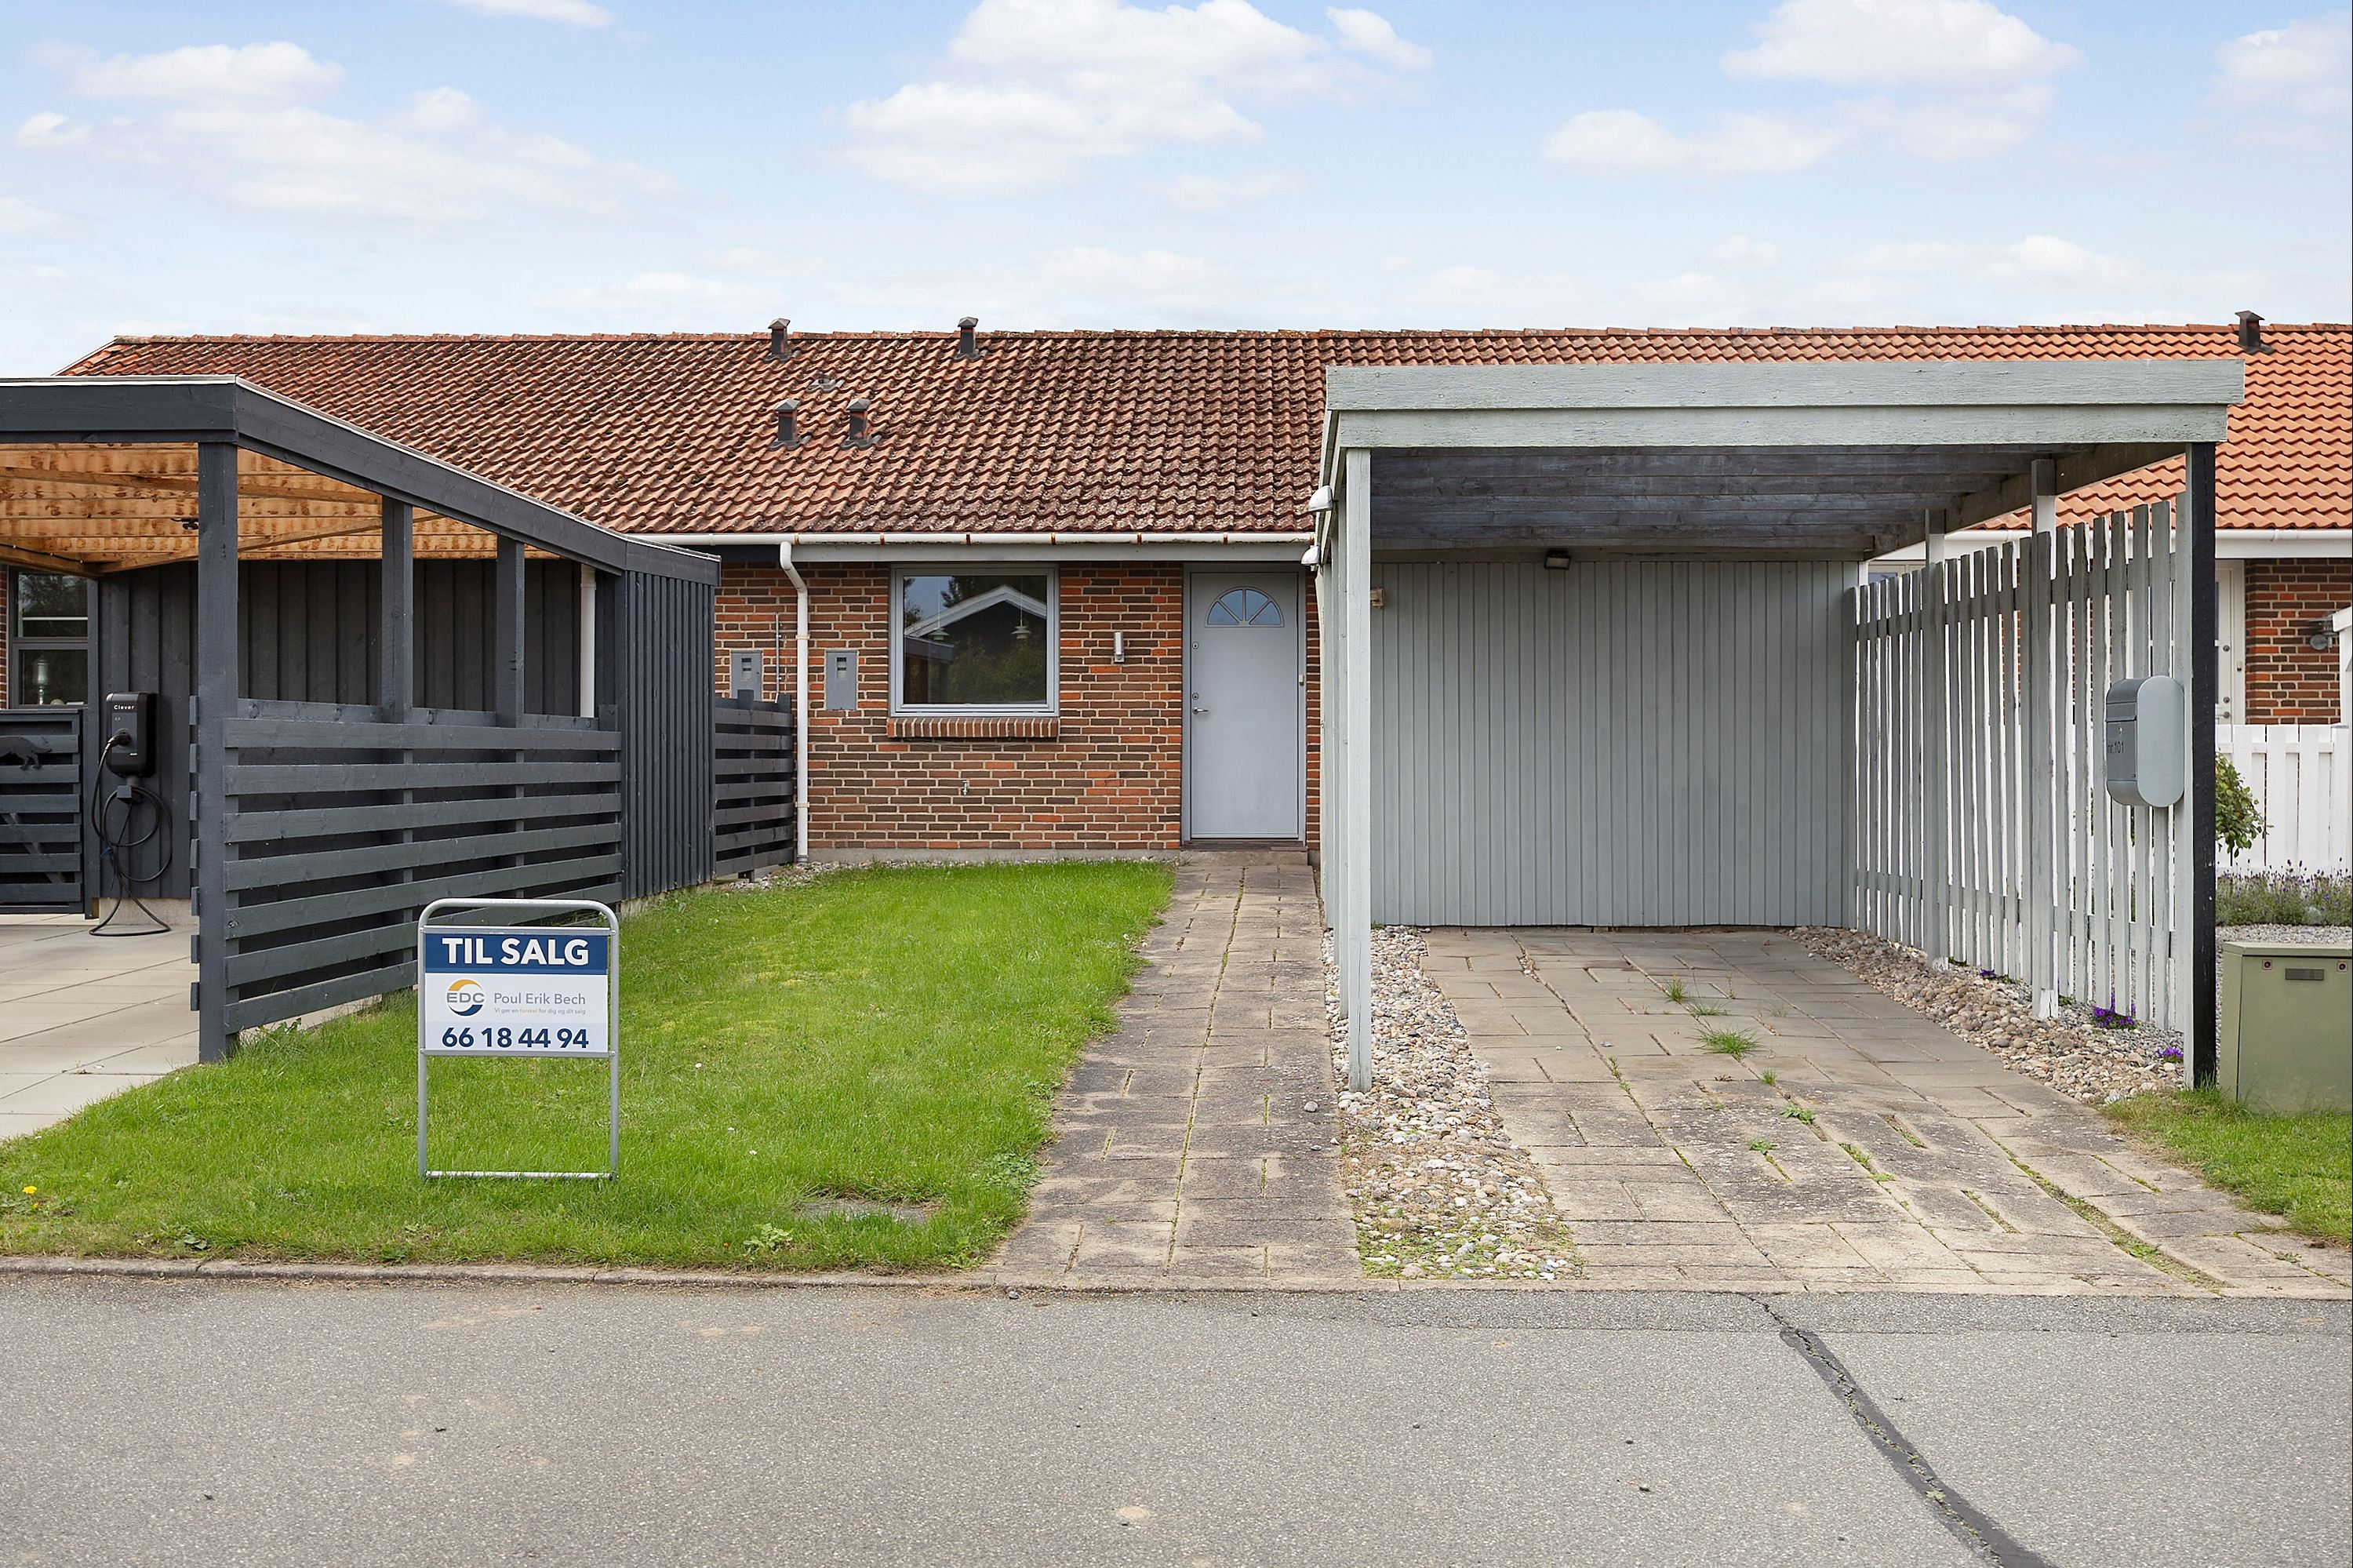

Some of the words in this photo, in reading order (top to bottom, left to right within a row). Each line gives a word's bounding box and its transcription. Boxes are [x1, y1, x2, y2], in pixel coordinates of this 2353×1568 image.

[442, 937, 493, 964] TIL
[500, 938, 589, 966] SALG
[446, 992, 485, 1003] EDC
[494, 992, 522, 1004] Poul
[526, 993, 551, 1004] Erik
[554, 993, 586, 1005] Bech
[442, 1027, 475, 1047] 66
[481, 1028, 512, 1048] 18
[518, 1028, 551, 1048] 44
[556, 1028, 589, 1049] 94
